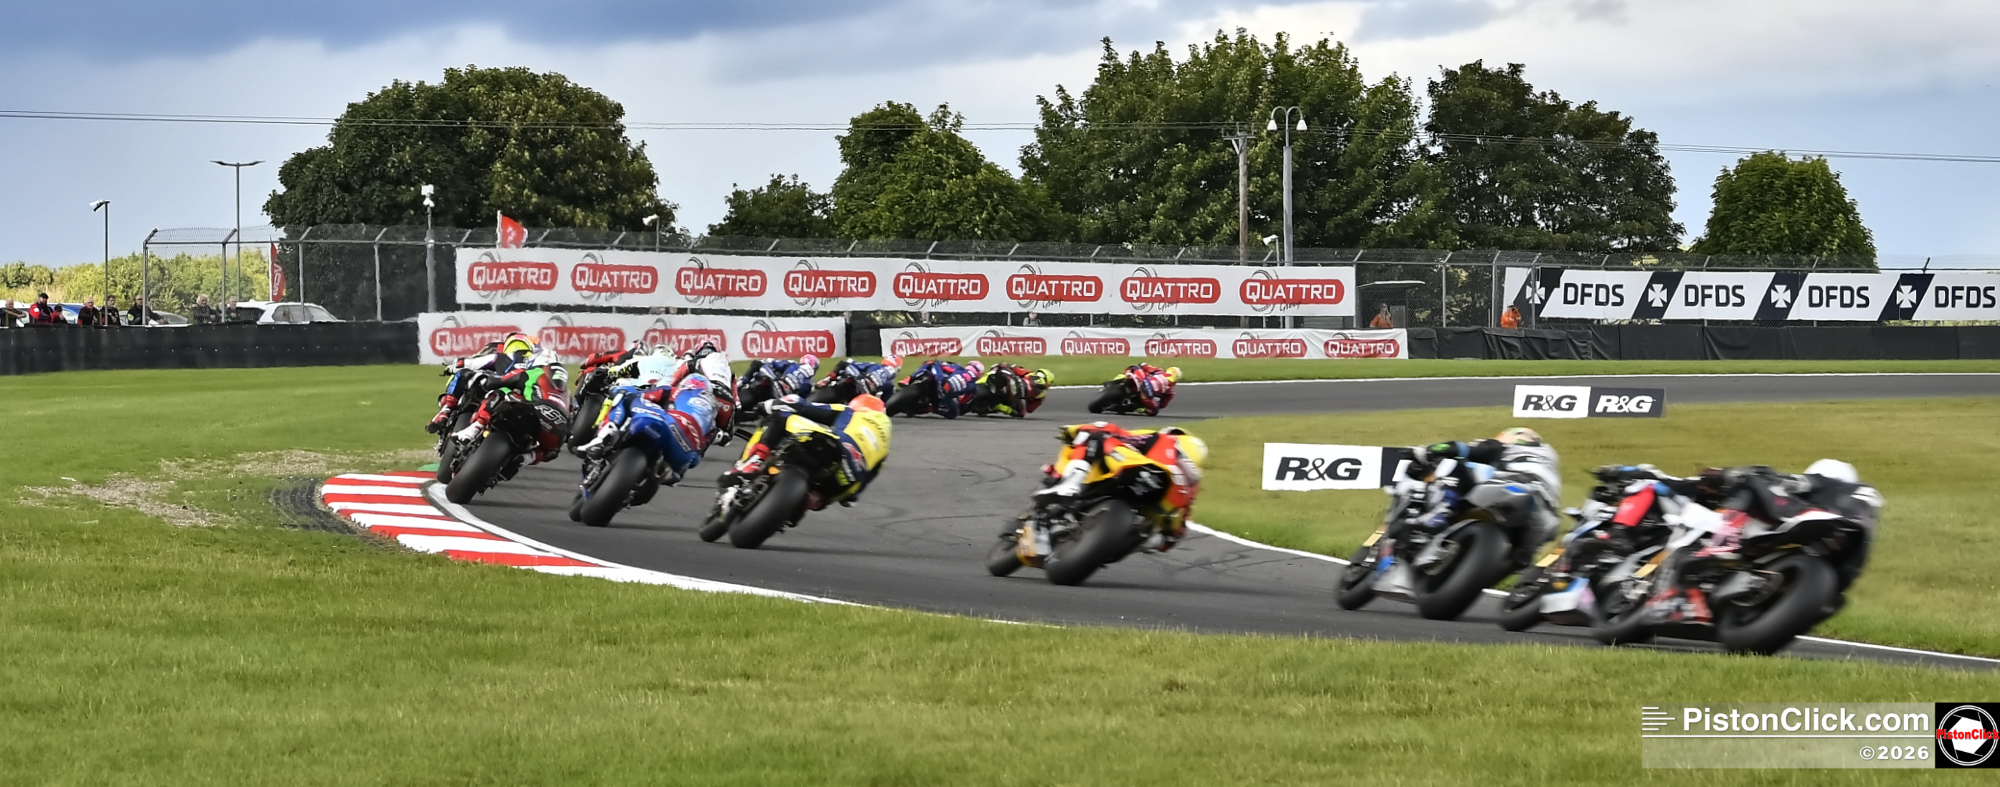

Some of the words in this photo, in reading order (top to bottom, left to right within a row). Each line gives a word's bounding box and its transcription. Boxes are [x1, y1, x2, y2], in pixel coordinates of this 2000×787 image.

[473, 266, 552, 288] QUATTRO
[575, 266, 652, 288] QUATTRO
[680, 270, 762, 293] QUATTRO
[788, 273, 870, 294] QUATTRO
[899, 275, 981, 296] QUATTRO
[1012, 277, 1096, 298] QUATTRO
[1126, 280, 1213, 300] QUATTRO
[1246, 282, 1336, 302] QUATTRO
[1563, 282, 1624, 307] DFDS
[1684, 284, 1745, 308] DFDS
[1808, 285, 1870, 308] DFDS
[1935, 286, 1996, 309] DFDS
[541, 329, 619, 351] QUATTRO
[746, 333, 828, 356] QUATTRO
[896, 341, 957, 356] QUATTRO
[980, 338, 1043, 355] QUATTRO
[1064, 340, 1125, 355] QUATTRO
[1148, 341, 1211, 356] QUATTRO
[1236, 341, 1302, 356] QUATTRO
[1328, 341, 1394, 355] QUATTRO
[1522, 394, 1578, 411] R&G
[1595, 394, 1654, 413] R&G
[534, 404, 568, 425] RST
[1275, 456, 1362, 481] R&G
